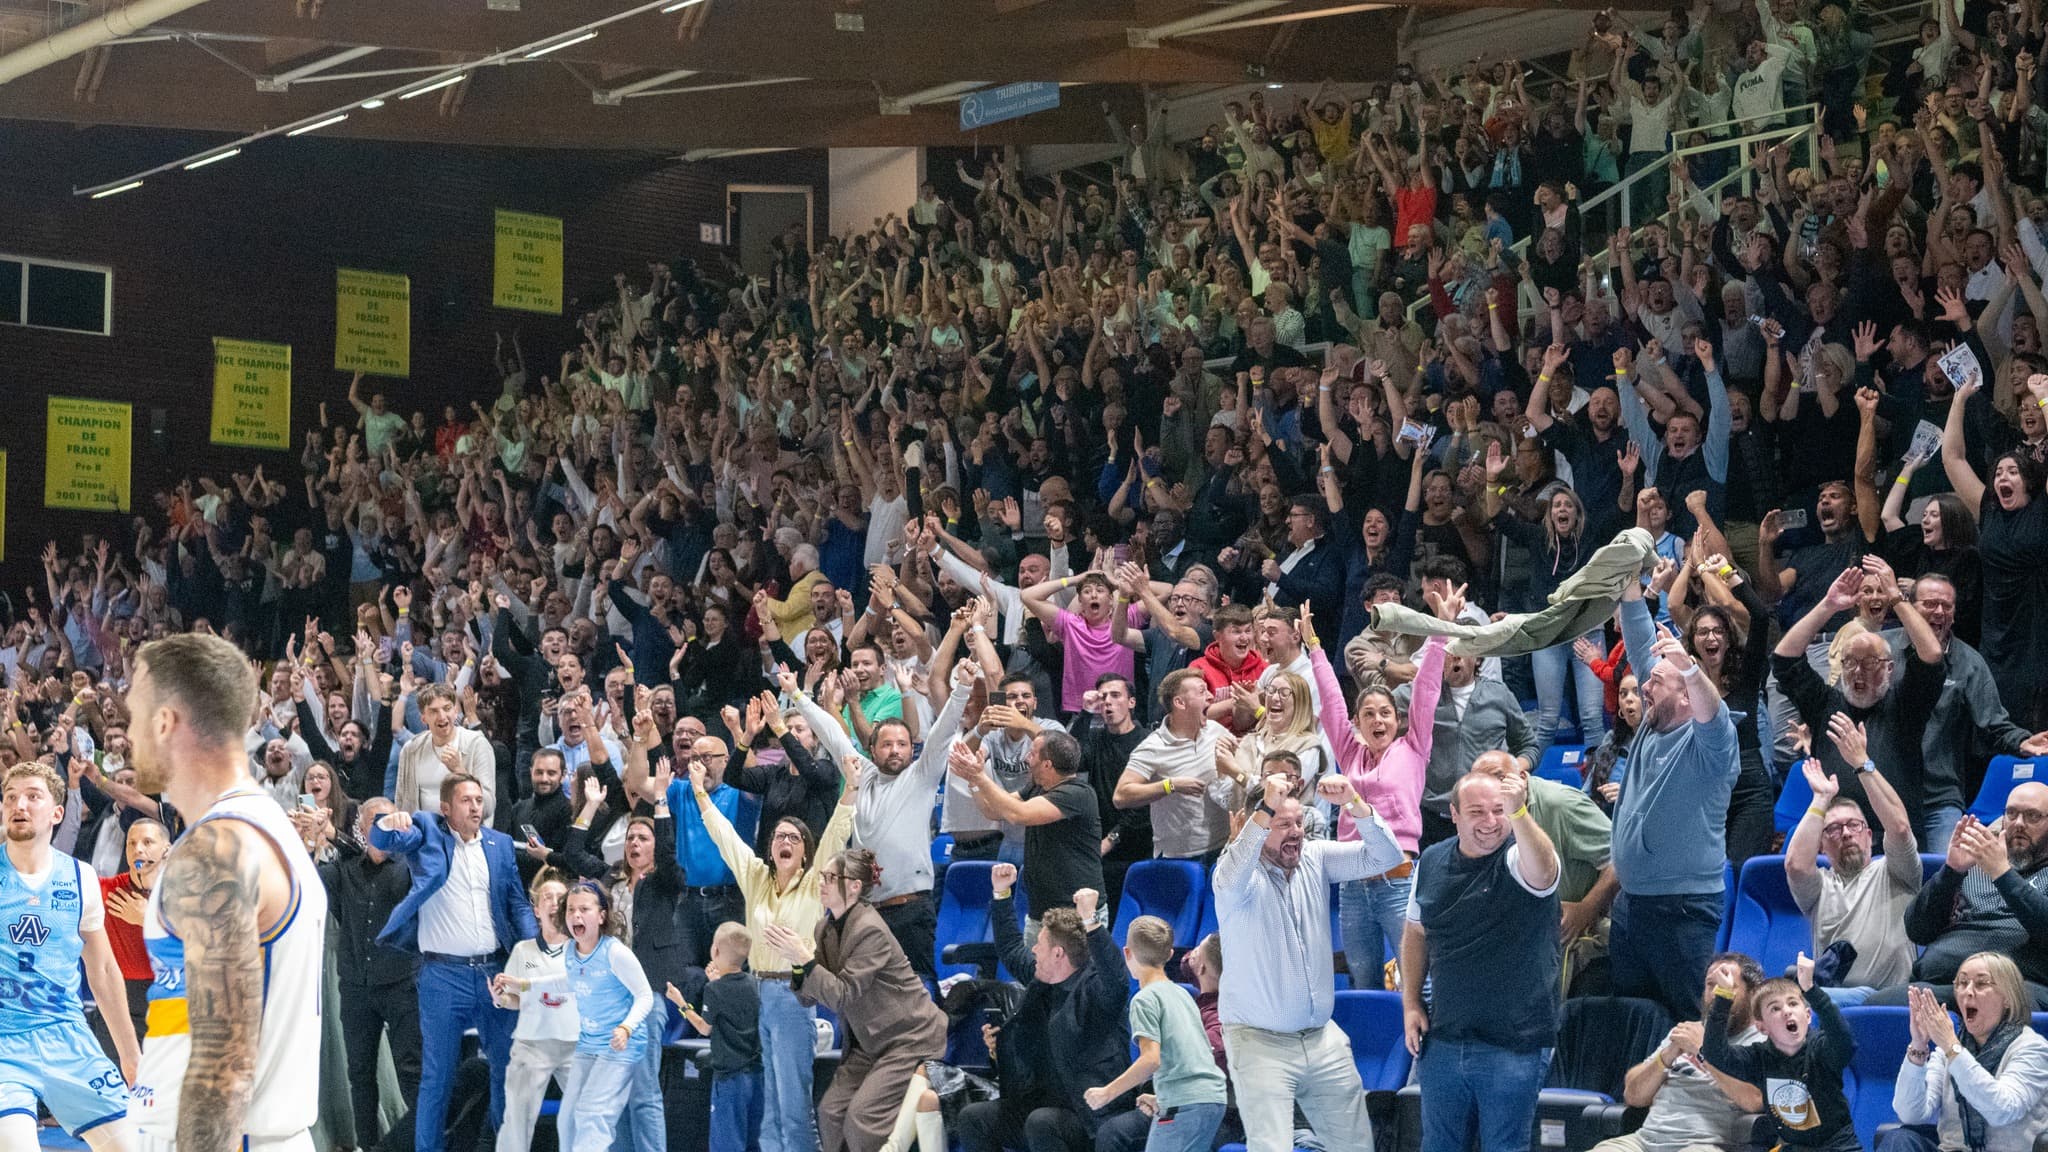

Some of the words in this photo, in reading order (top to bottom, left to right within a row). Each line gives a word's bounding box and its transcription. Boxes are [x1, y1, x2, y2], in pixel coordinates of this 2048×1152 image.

[1740, 74, 1764, 93] PUMA
[996, 83, 1032, 100] TRIBUNE
[496, 226, 513, 236] VICE
[516, 228, 562, 242] CHAMPION
[702, 224, 721, 243] B1
[513, 252, 544, 264] FRANCE
[367, 301, 378, 310] DE
[356, 312, 390, 325] FRANCE
[238, 357, 290, 372] CHAMPION
[246, 371, 258, 381] DE
[233, 383, 270, 395] FRANCE
[57, 415, 121, 430] CHAMPION
[82, 431, 97, 441] DE
[66, 444, 111, 457] FRANCE
[75, 462, 92, 471] Pro
[71, 479, 105, 490] Saison
[56, 491, 80, 502] 2001
